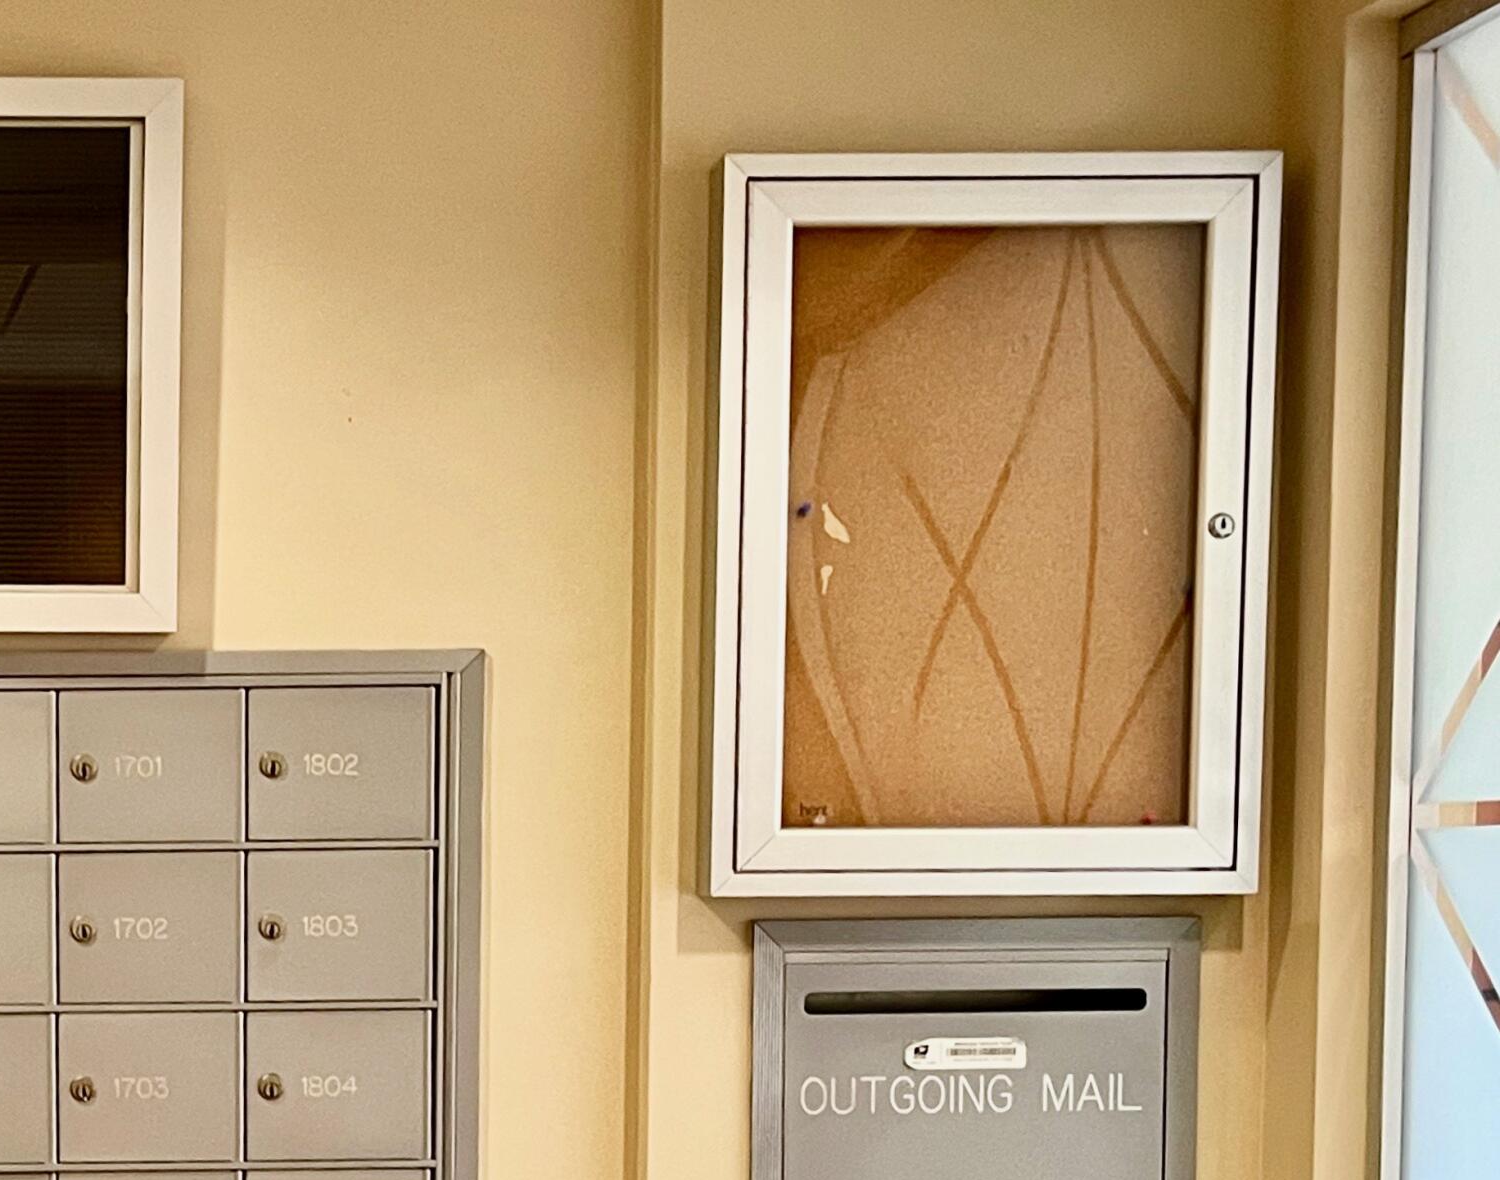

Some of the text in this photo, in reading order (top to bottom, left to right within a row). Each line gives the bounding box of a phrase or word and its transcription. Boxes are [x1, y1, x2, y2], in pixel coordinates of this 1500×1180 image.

[113, 755, 163, 779] 1701
[302, 753, 359, 778] 1802
[113, 917, 168, 941] 1702
[302, 915, 358, 939] 1803
[113, 1077, 169, 1101] 1703
[301, 1075, 358, 1098] 1804
[799, 1072, 1143, 1116] OUTGOING MAIL
